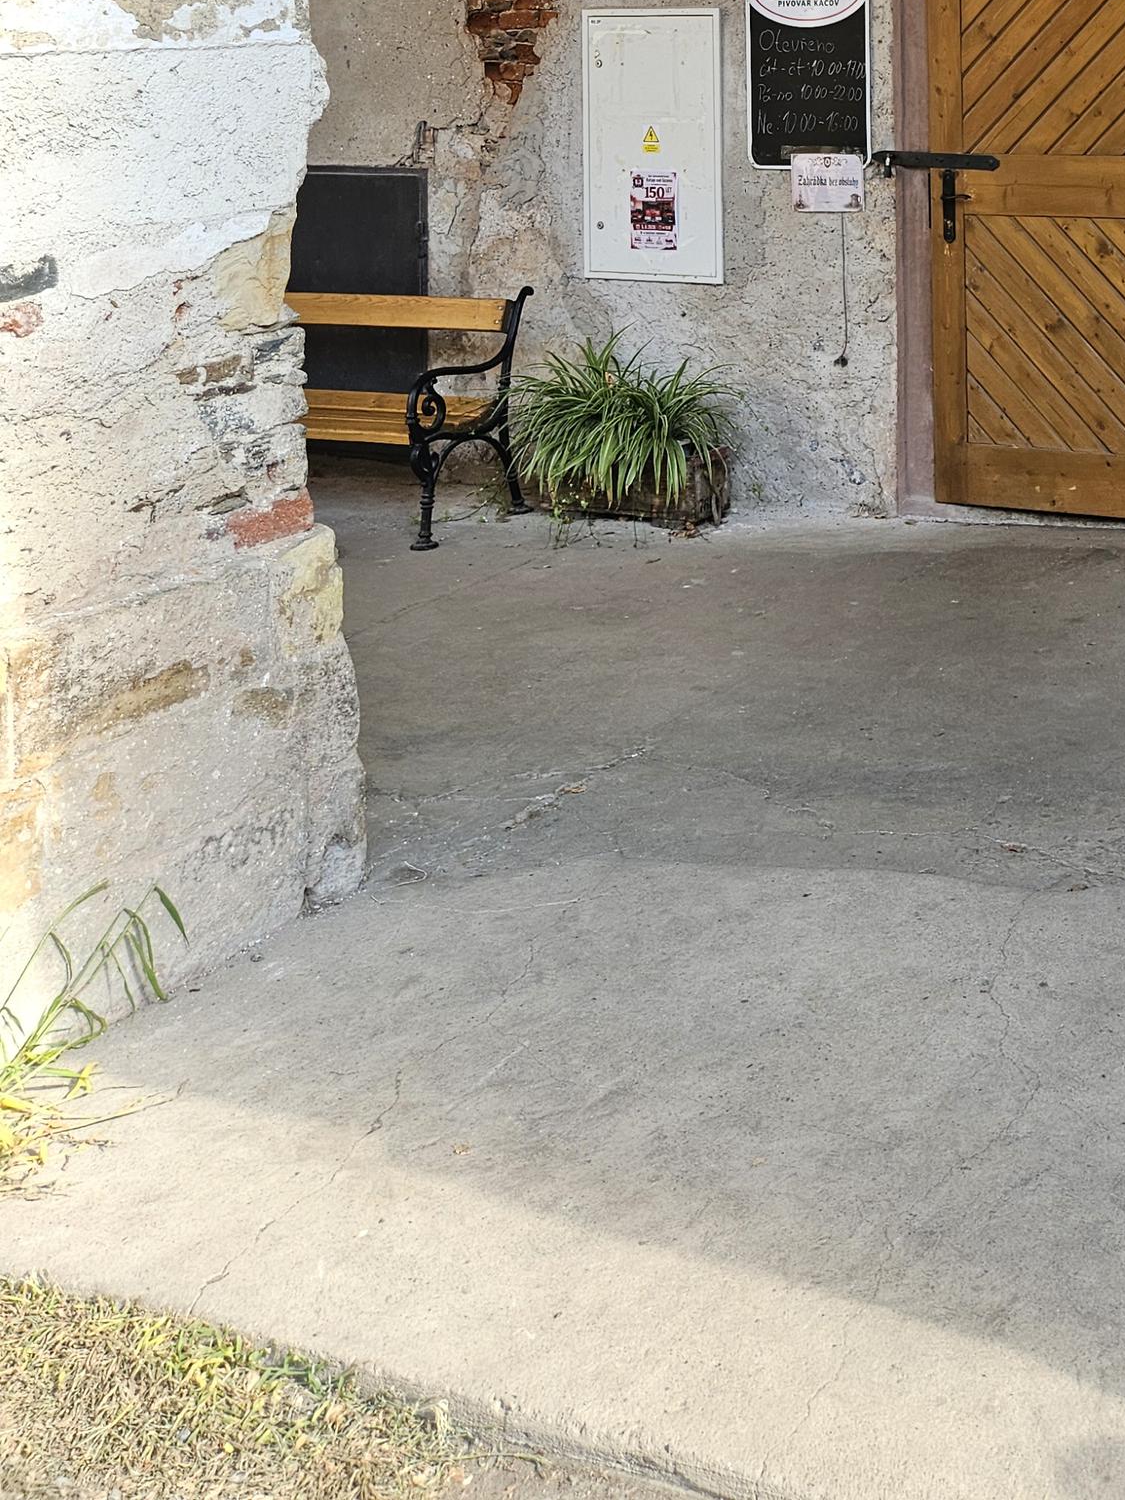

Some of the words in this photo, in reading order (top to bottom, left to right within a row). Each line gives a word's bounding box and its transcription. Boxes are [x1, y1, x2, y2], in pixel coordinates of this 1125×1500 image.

[778, 0, 811, 7] PIVOVAR
[759, 29, 835, 54] Otevřeno
[645, 186, 665, 199] 150
